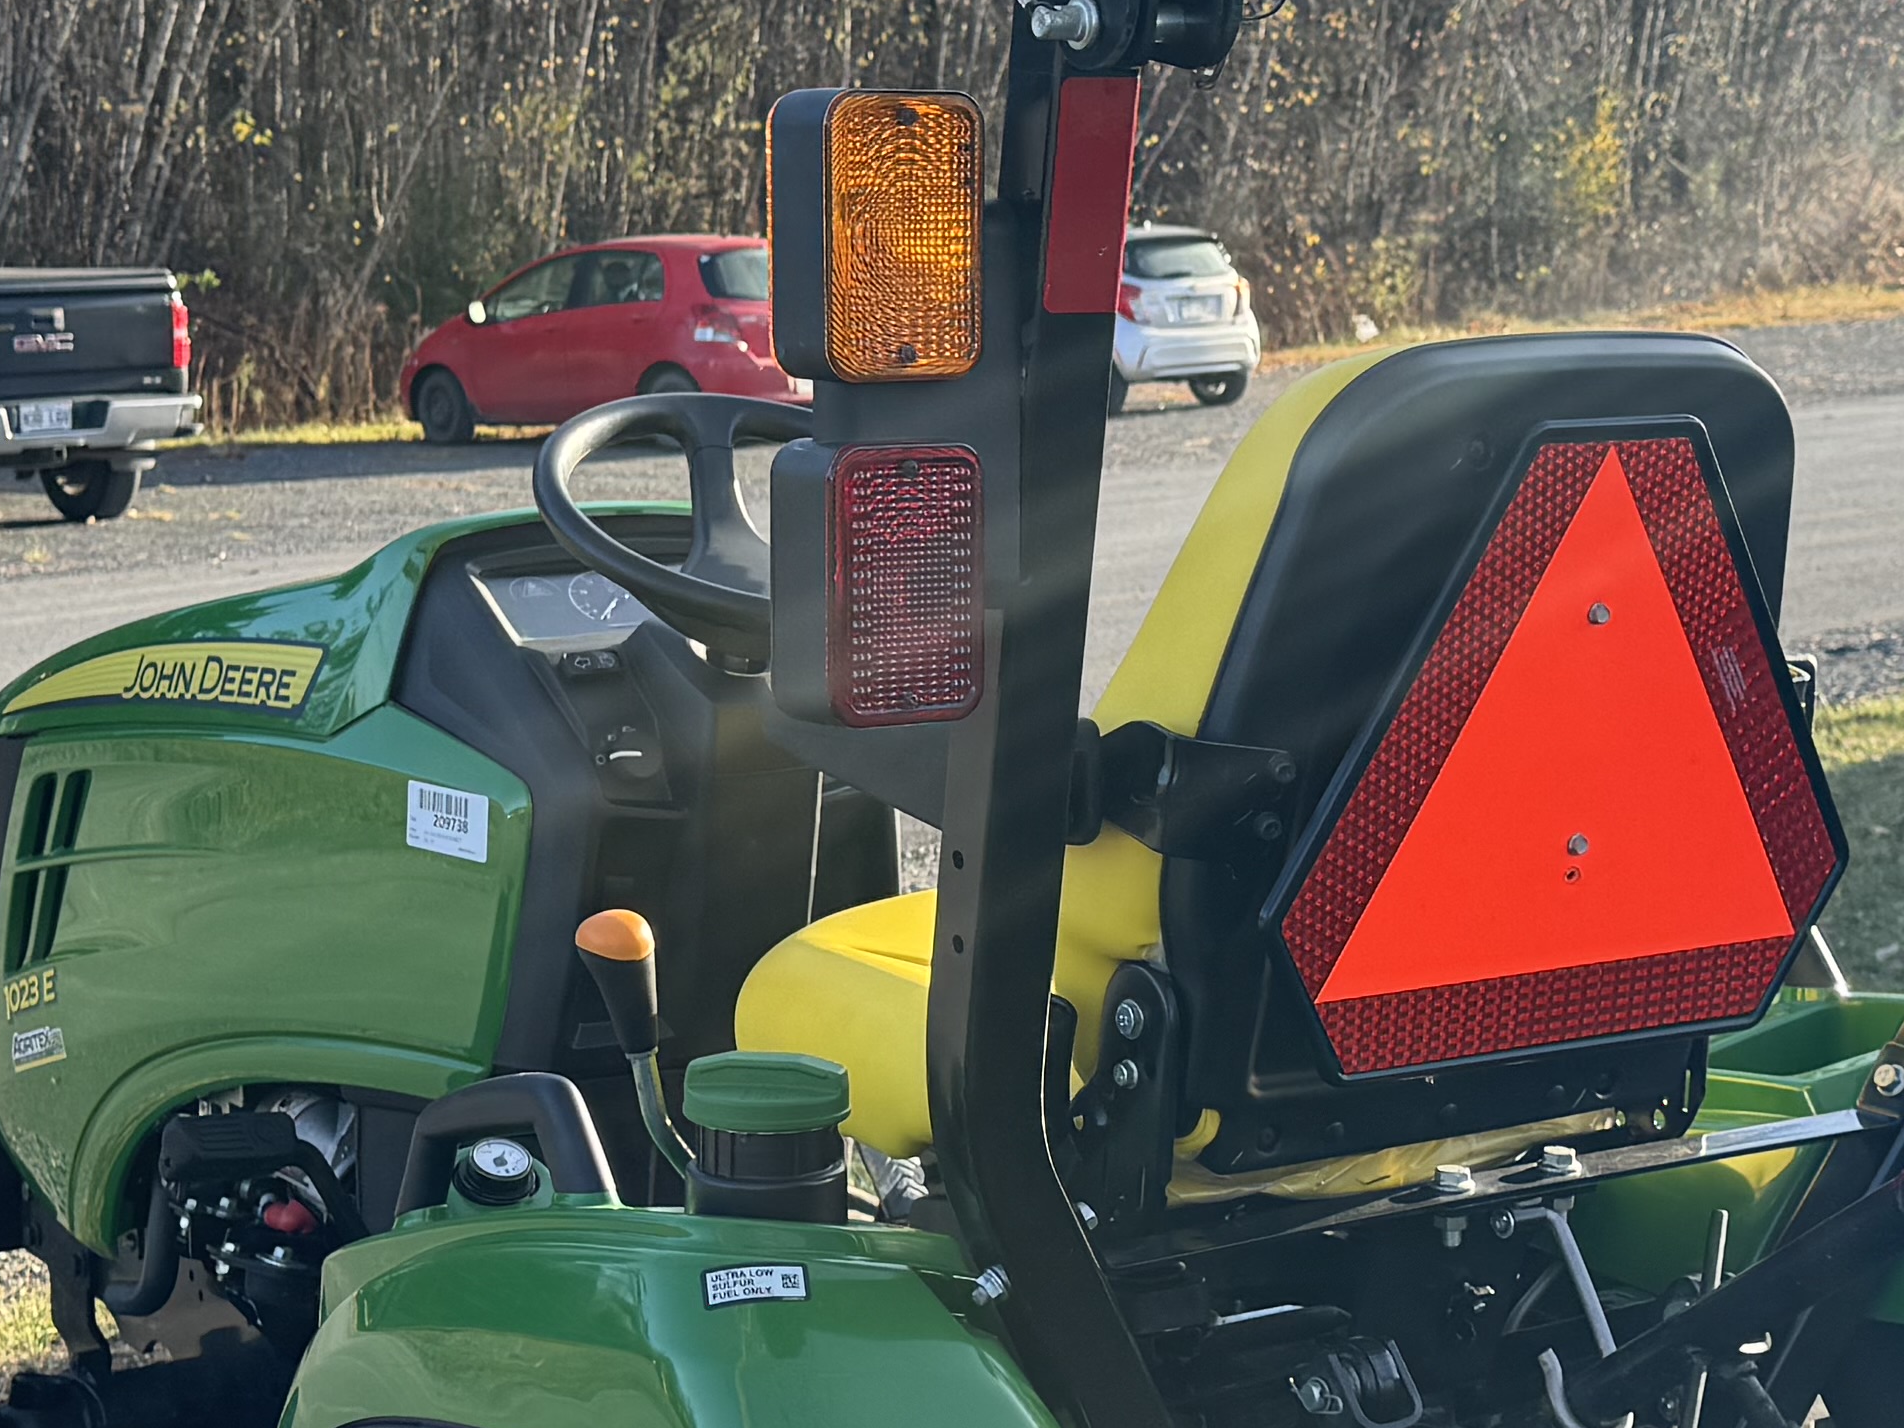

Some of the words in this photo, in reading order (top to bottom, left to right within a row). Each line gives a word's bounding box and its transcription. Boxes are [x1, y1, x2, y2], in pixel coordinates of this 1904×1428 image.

[13, 332, 75, 353] GMC
[123, 655, 195, 699] JOHN
[198, 655, 299, 706] DEERE
[3, 975, 40, 1021] 1023
[42, 968, 57, 1003] E
[711, 1271, 747, 1282] ULTRA
[749, 1268, 774, 1278] LOW
[712, 1279, 755, 1291] SULFUR
[712, 1289, 740, 1301] FUEL
[743, 1286, 772, 1295] ONLY
